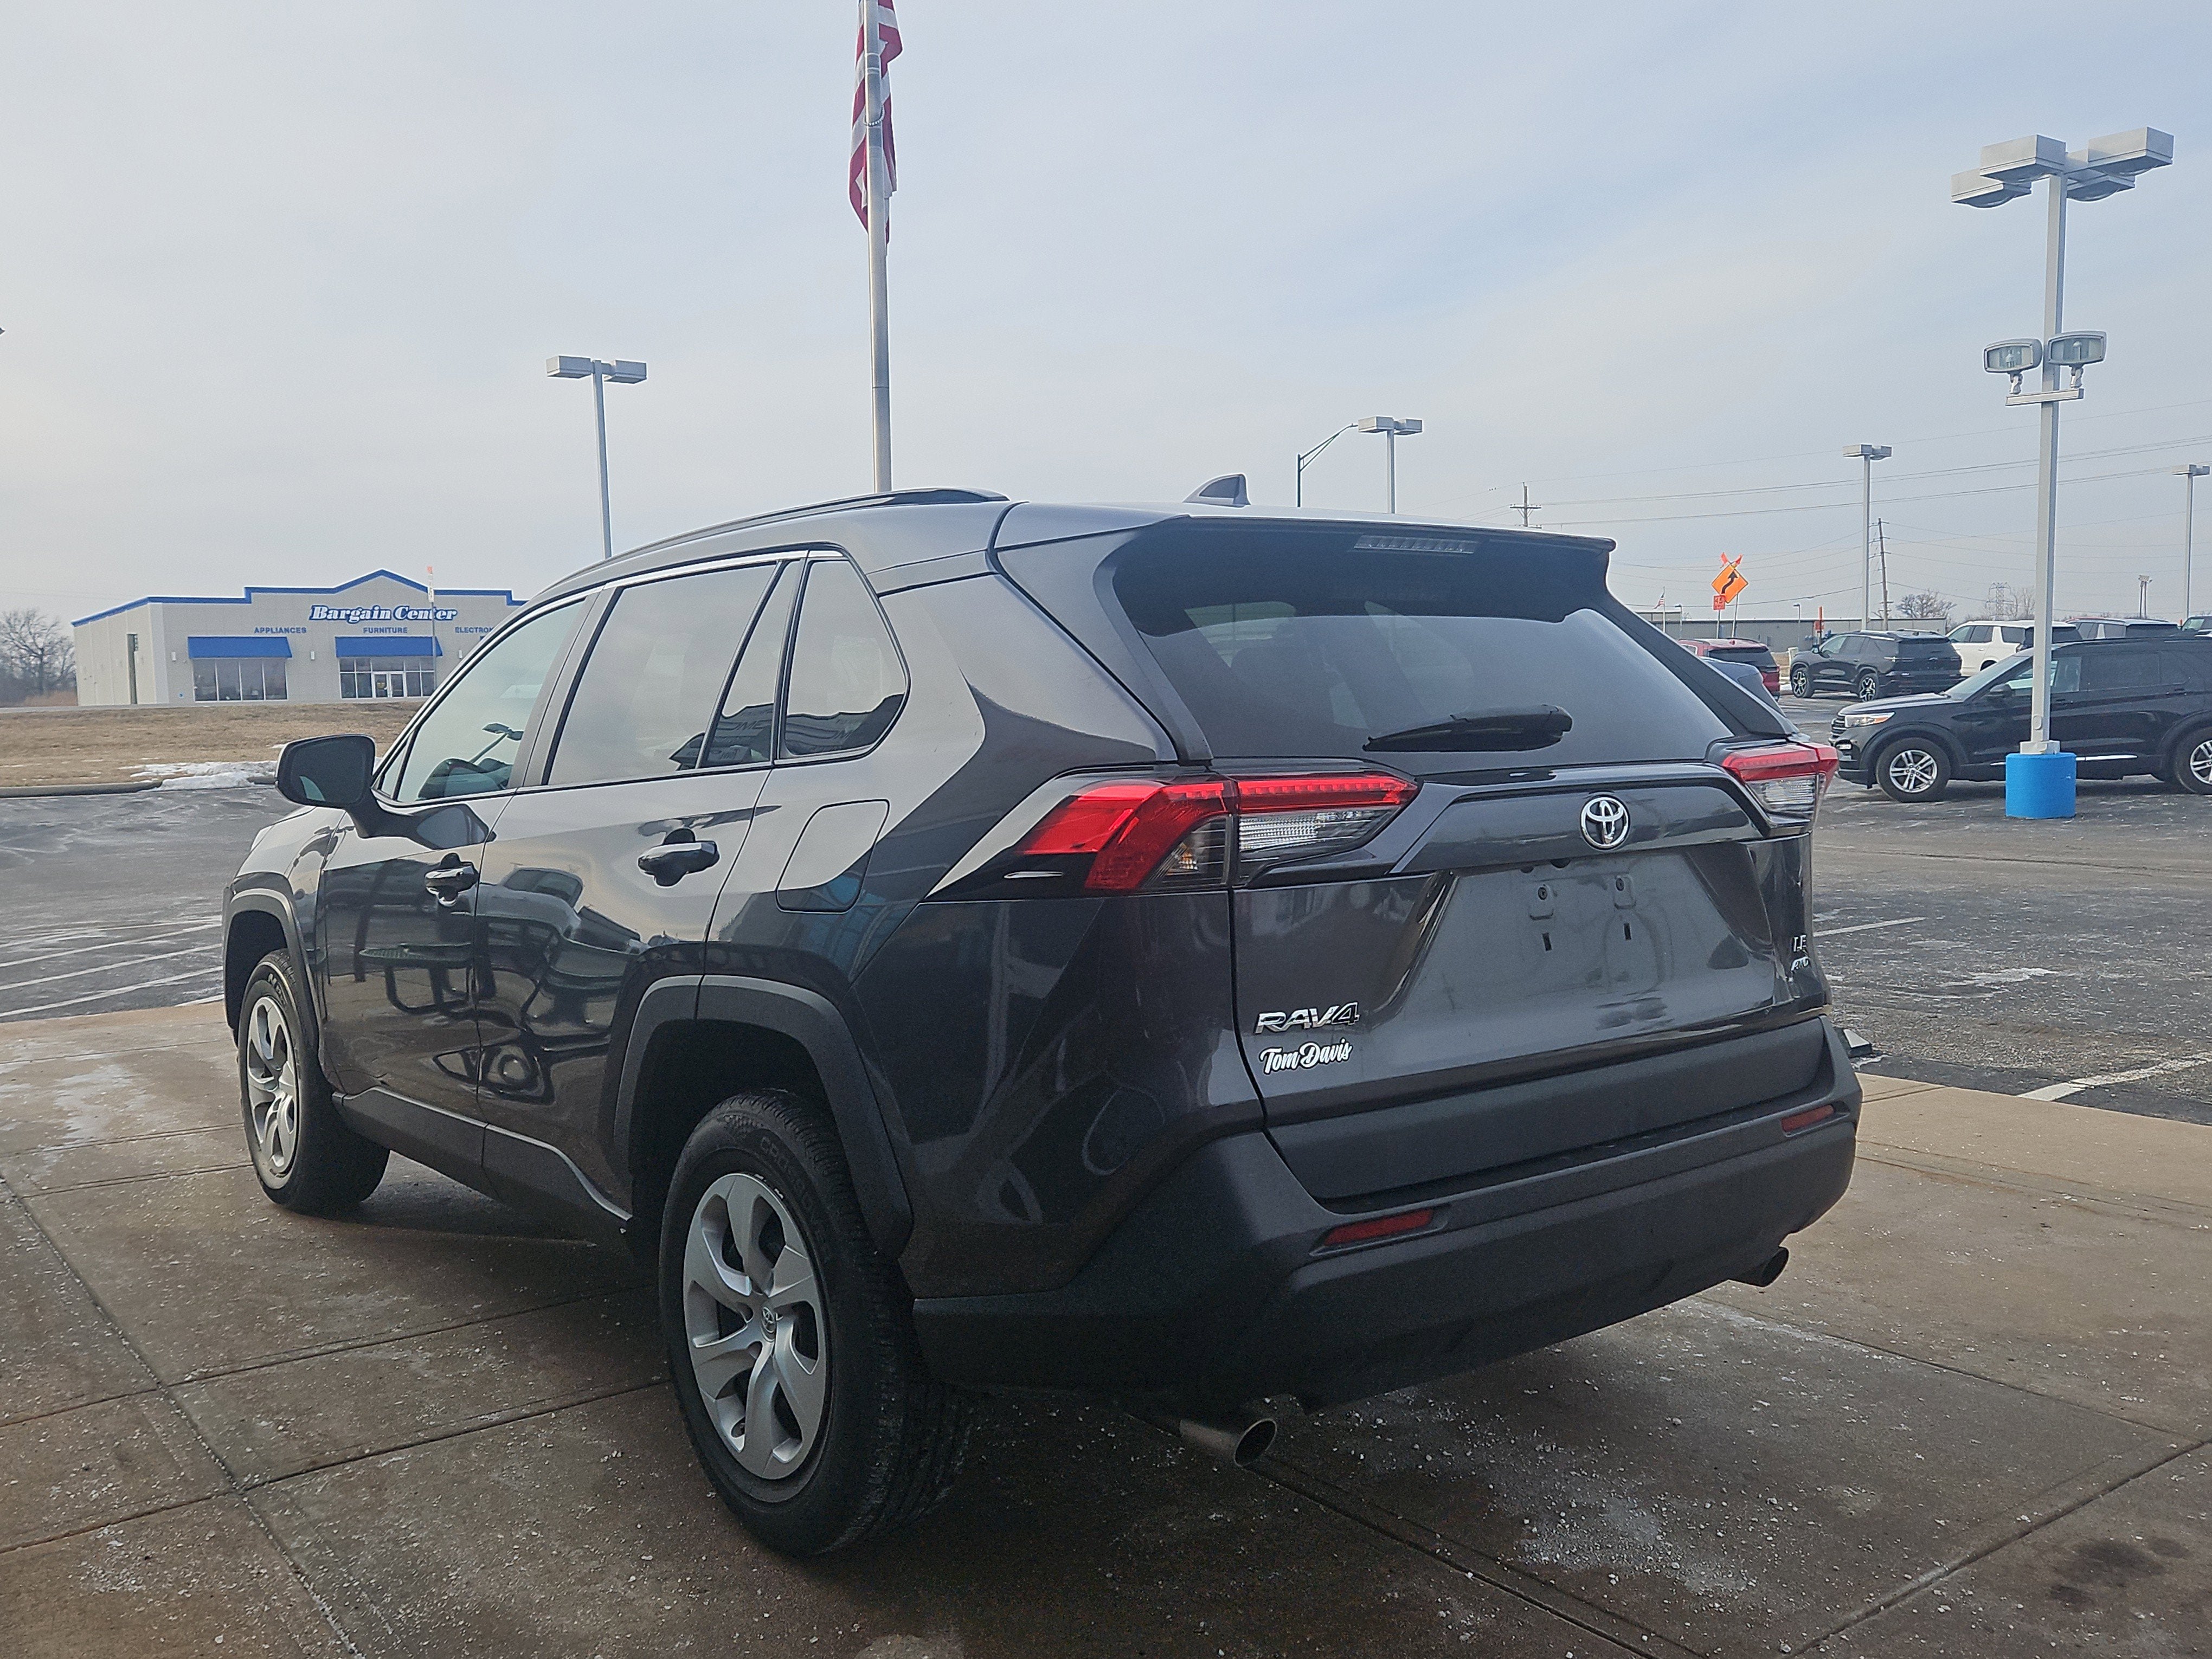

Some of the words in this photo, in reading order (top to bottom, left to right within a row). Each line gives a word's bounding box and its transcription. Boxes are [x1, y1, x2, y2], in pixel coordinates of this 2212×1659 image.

[311, 605, 391, 623] Bargain
[393, 606, 457, 620] Center
[1255, 1002, 1360, 1034] RAV4
[1259, 1047, 1301, 1075] Tom
[1299, 1038, 1353, 1069] Davis
